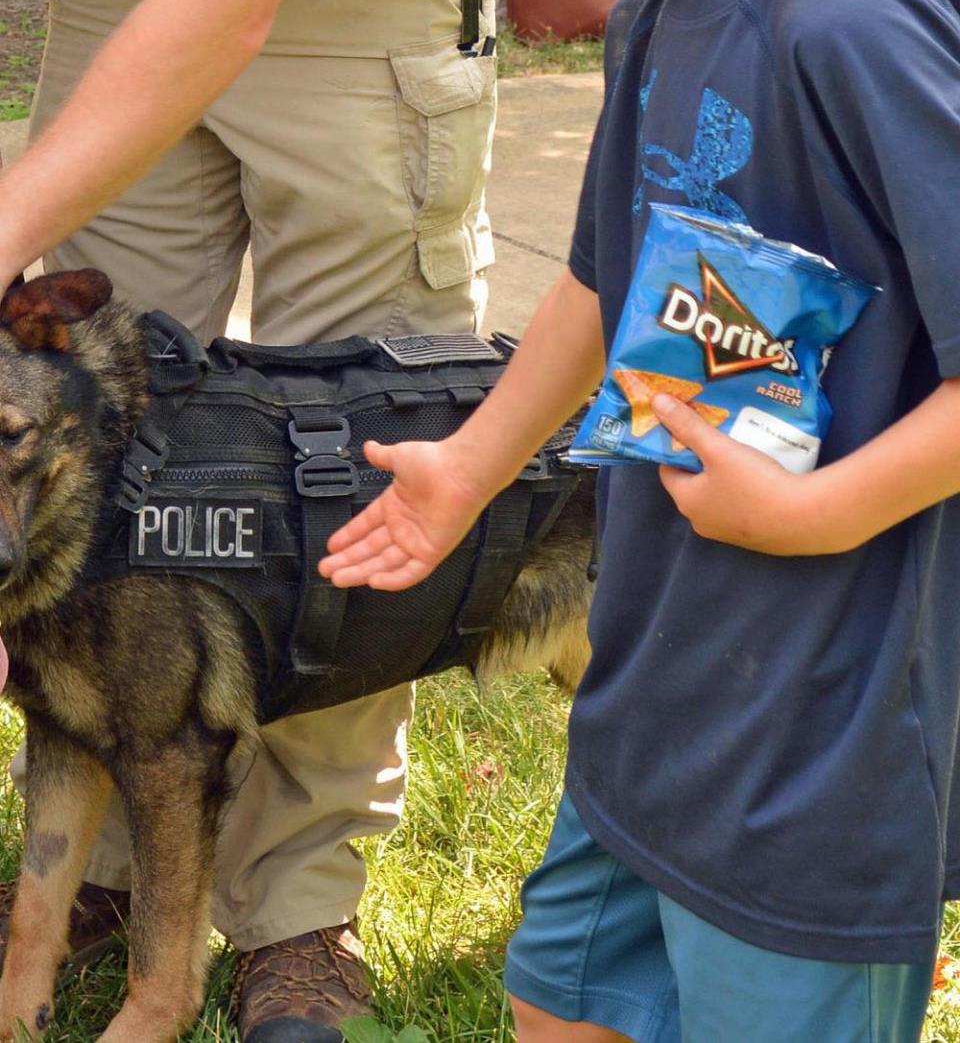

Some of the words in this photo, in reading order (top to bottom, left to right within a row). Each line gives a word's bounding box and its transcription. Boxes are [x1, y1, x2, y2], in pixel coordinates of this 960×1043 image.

[755, 386, 803, 408] RANCH
[769, 381, 801, 399] COOL
[598, 415, 622, 436] 150
[137, 505, 255, 558] POLICE
